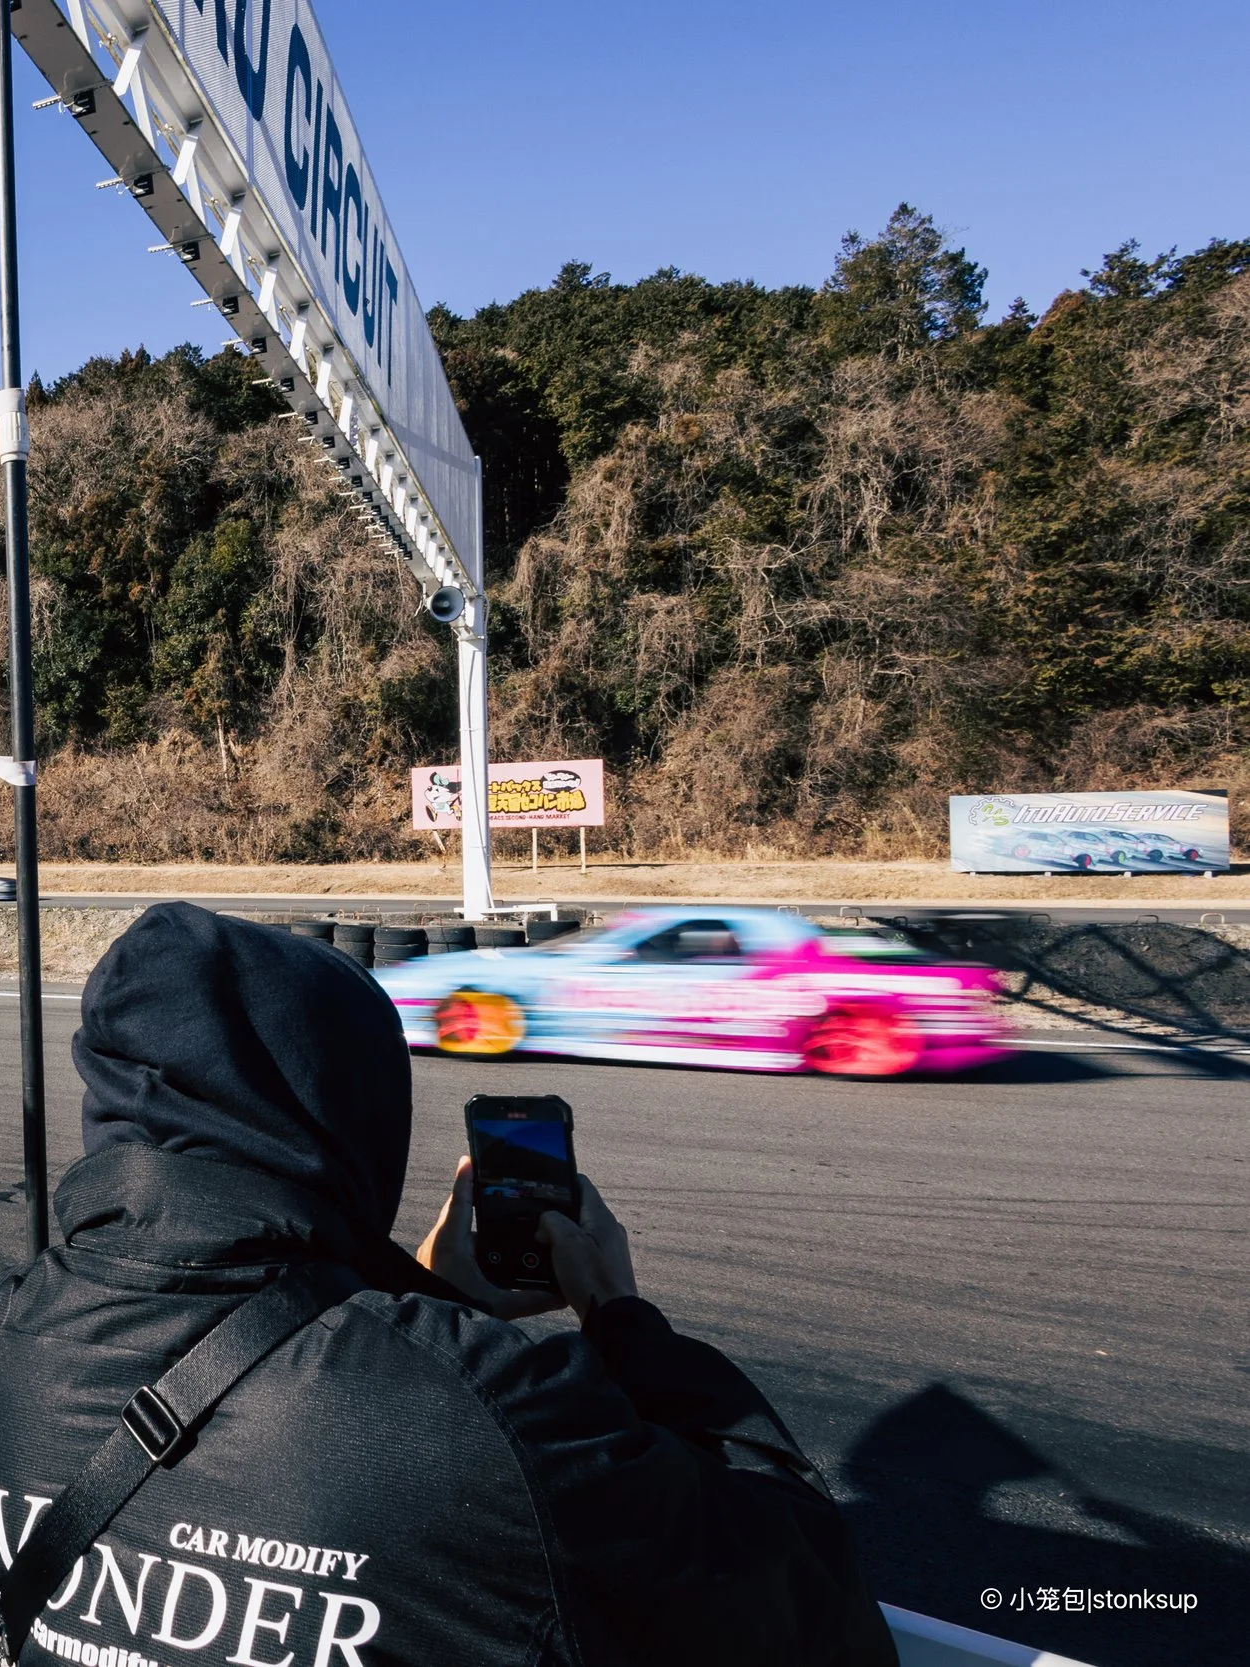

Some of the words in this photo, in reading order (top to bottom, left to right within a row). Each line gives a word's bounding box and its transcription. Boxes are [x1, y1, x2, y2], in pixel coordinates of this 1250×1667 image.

[284, 23, 398, 388] CIRCUIT
[170, 1523, 228, 1557] CAR
[233, 1534, 369, 1580] MODIFY
